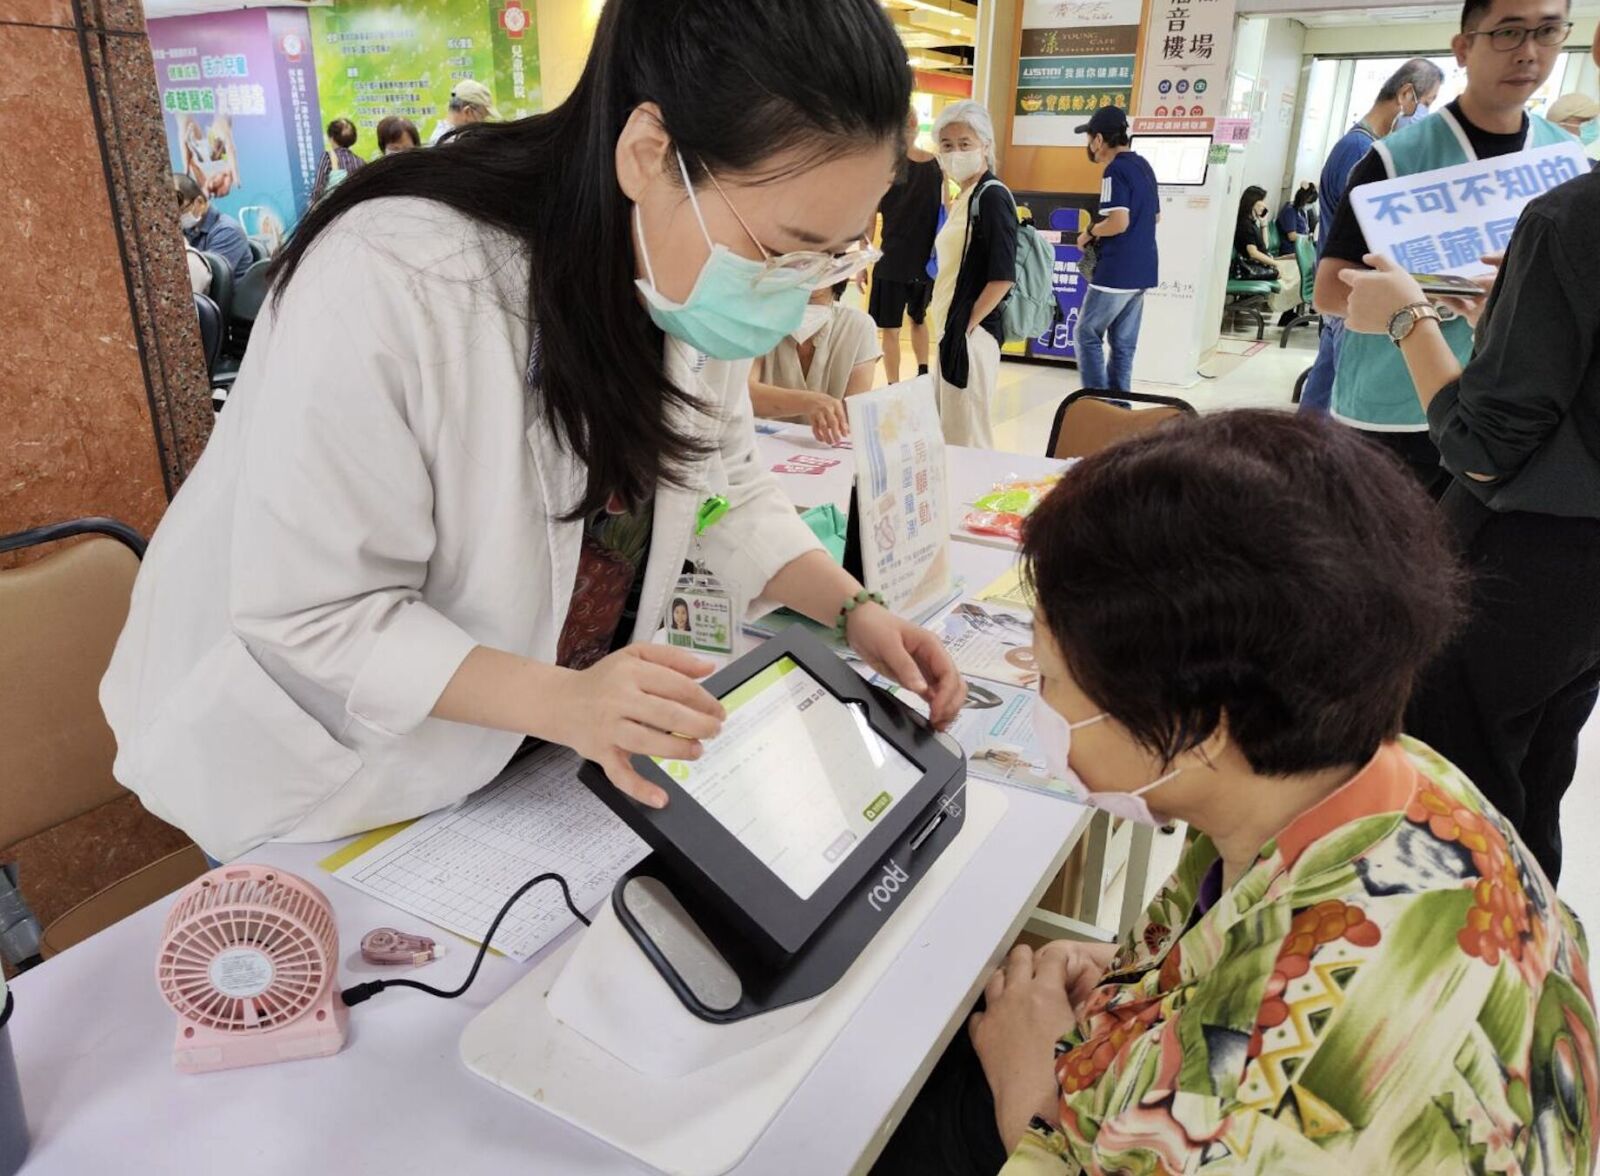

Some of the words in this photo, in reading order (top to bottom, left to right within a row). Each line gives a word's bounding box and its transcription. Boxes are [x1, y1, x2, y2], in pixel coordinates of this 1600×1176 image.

[1161, 0, 1192, 60] 音樓
[1367, 155, 1580, 226] 不可不知的
[867, 858, 910, 912] rooti
